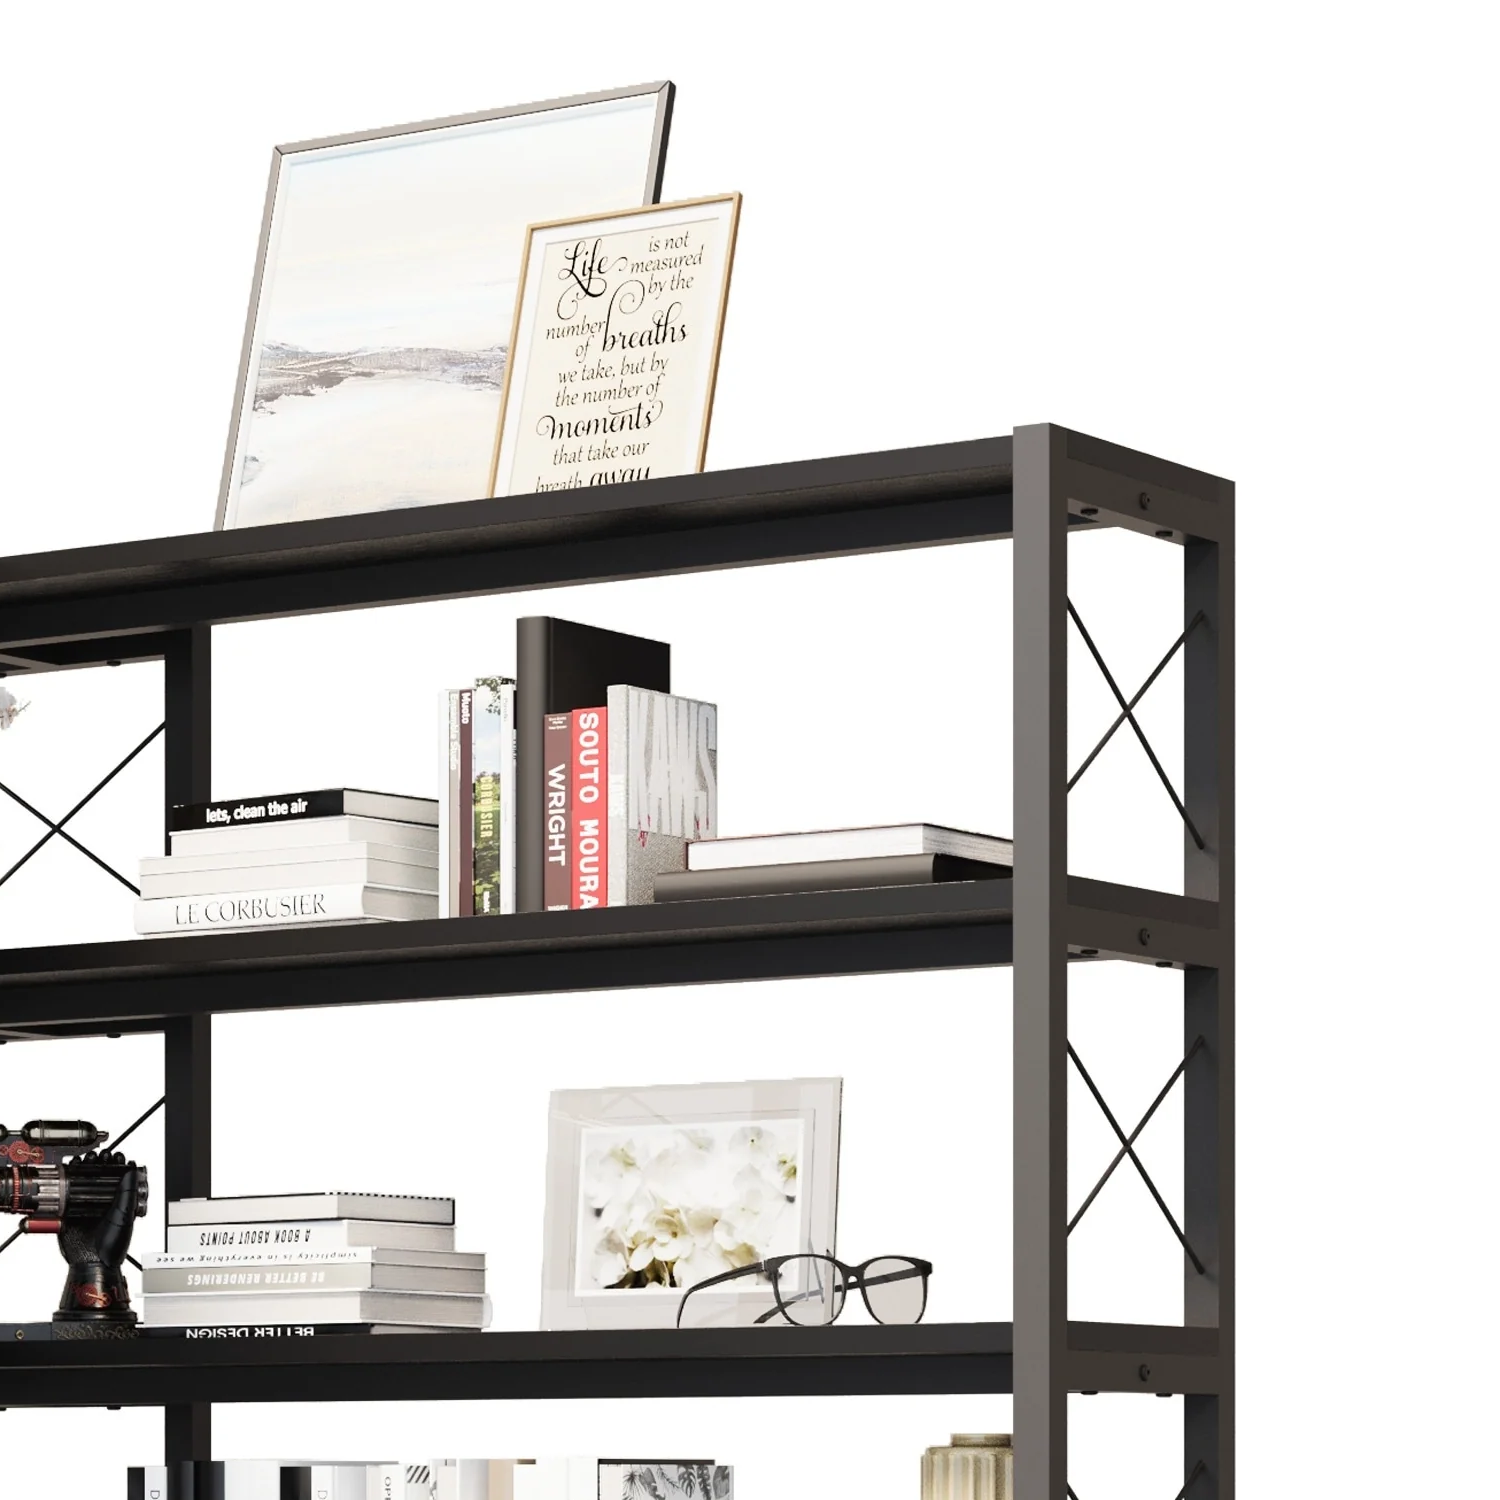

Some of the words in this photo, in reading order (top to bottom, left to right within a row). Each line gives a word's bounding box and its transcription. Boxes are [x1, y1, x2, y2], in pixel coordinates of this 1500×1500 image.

[648, 236, 661, 253] is
[664, 231, 689, 250] not
[630, 243, 704, 275] measured
[648, 276, 667, 300] by
[670, 273, 694, 290] the
[546, 319, 605, 340] number
[575, 335, 594, 364] of
[602, 281, 688, 352] breaths
[558, 368, 577, 384] we
[581, 358, 616, 382] take,
[620, 356, 646, 377] but
[650, 351, 670, 374] by
[555, 386, 577, 407] the
[583, 379, 643, 403] number
[646, 373, 667, 401] of
[553, 444, 583, 466] that
[587, 440, 619, 463] take
[622, 441, 650, 457] our
[578, 712, 600, 804] SOUTO
[205, 807, 232, 824] lets,
[232, 804, 266, 820] clean
[267, 800, 289, 817] the
[290, 797, 309, 814] air
[480, 776, 494, 839] CORBUSIER
[547, 763, 566, 867] WRIGHT
[578, 818, 600, 910] MOURA
[174, 903, 201, 926] LE
[204, 892, 328, 924] CORBUSIER
[199, 1231, 235, 1246] POINTS
[238, 1230, 271, 1245] ABOUT
[274, 1229, 301, 1244] BOOK
[304, 1229, 311, 1243] A
[199, 1253, 262, 1263] everything
[298, 1251, 357, 1260] simplicity
[187, 1272, 261, 1286] RENDERINGS
[265, 1271, 307, 1285] BETTER
[311, 1271, 325, 1284] BE
